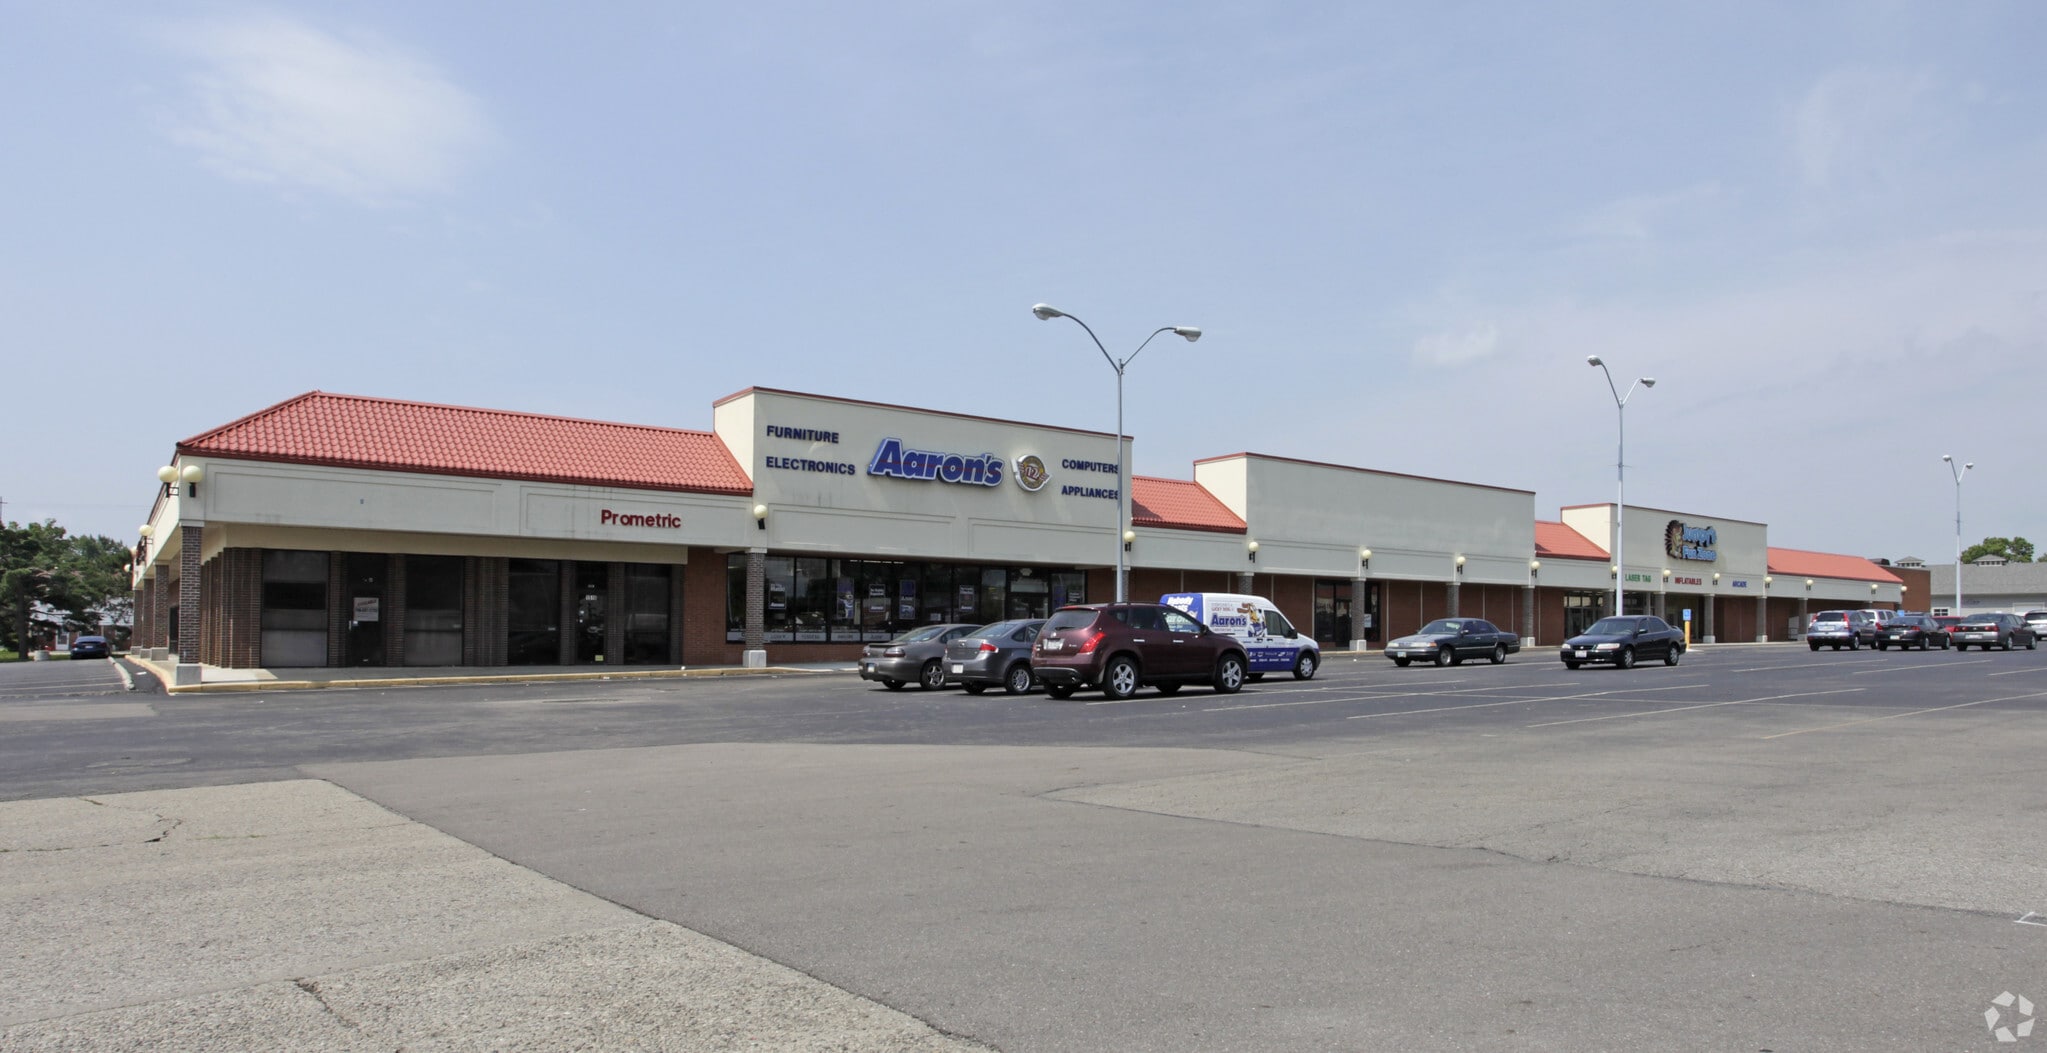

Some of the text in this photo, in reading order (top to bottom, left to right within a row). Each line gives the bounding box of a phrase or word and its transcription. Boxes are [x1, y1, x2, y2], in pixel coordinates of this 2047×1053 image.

[766, 425, 840, 444] FURNITURE
[766, 456, 856, 475] ELECTRONICS
[867, 437, 1004, 487] Aaron's
[601, 509, 681, 528] Prometric
[1642, 575, 1651, 583] TAG
[1674, 577, 1702, 586] INFLATABLES
